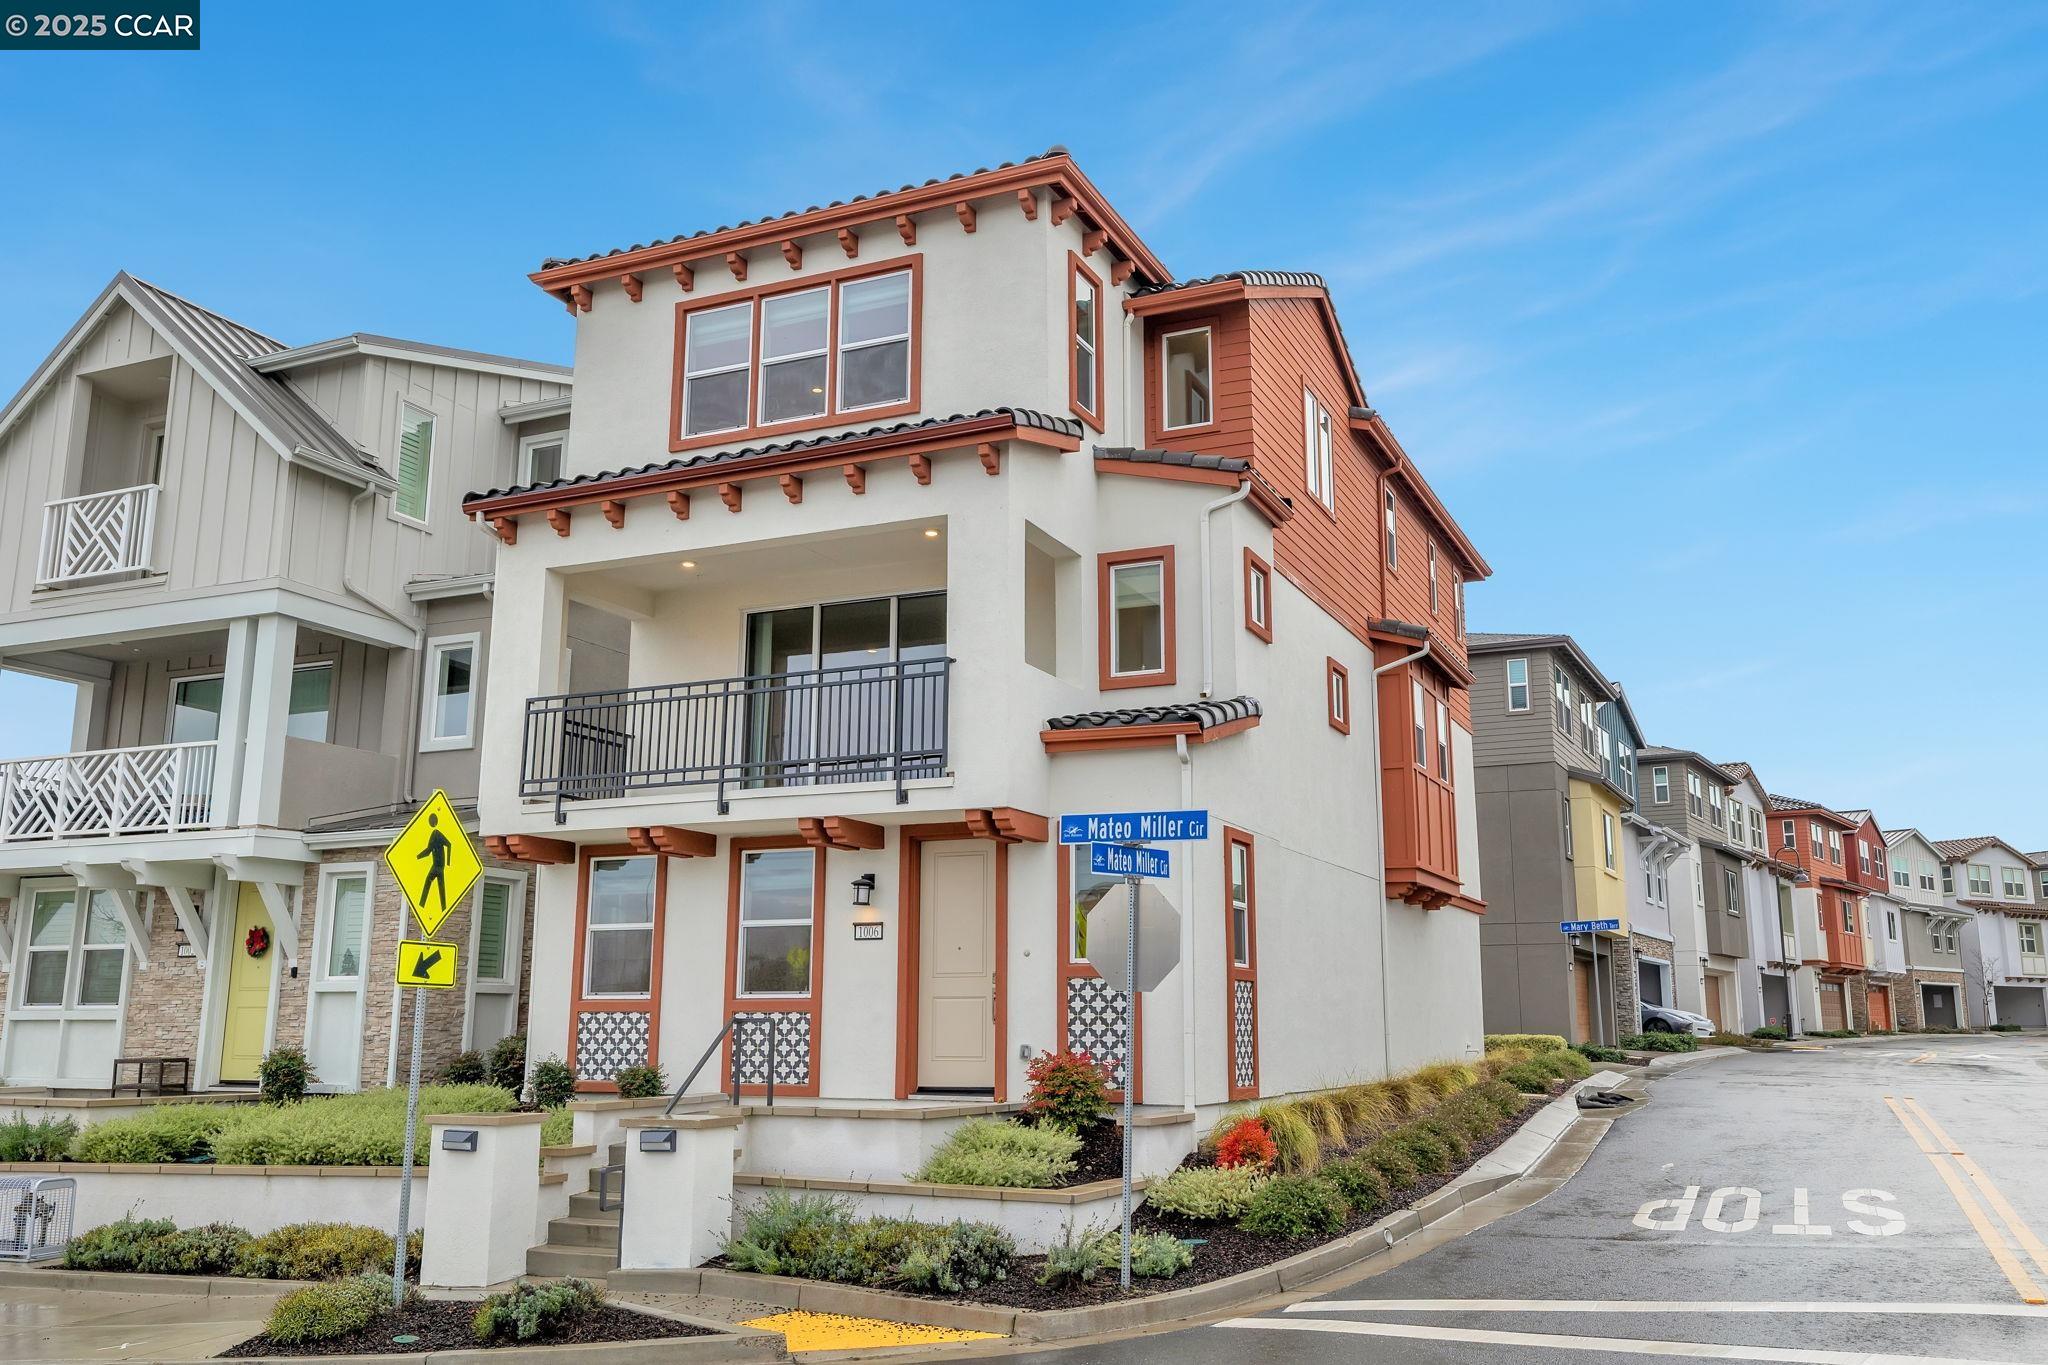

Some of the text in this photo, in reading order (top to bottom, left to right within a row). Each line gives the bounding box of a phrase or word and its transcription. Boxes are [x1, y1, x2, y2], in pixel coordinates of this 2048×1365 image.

[1088, 815, 1204, 839] Mateo Miller Cir
[1107, 847, 1168, 875] Mateo Miller Cir
[858, 926, 879, 938] 1006
[1570, 922, 1588, 931] Mary
[1591, 921, 1608, 930] Beth
[1632, 1185, 1906, 1236] STOP
